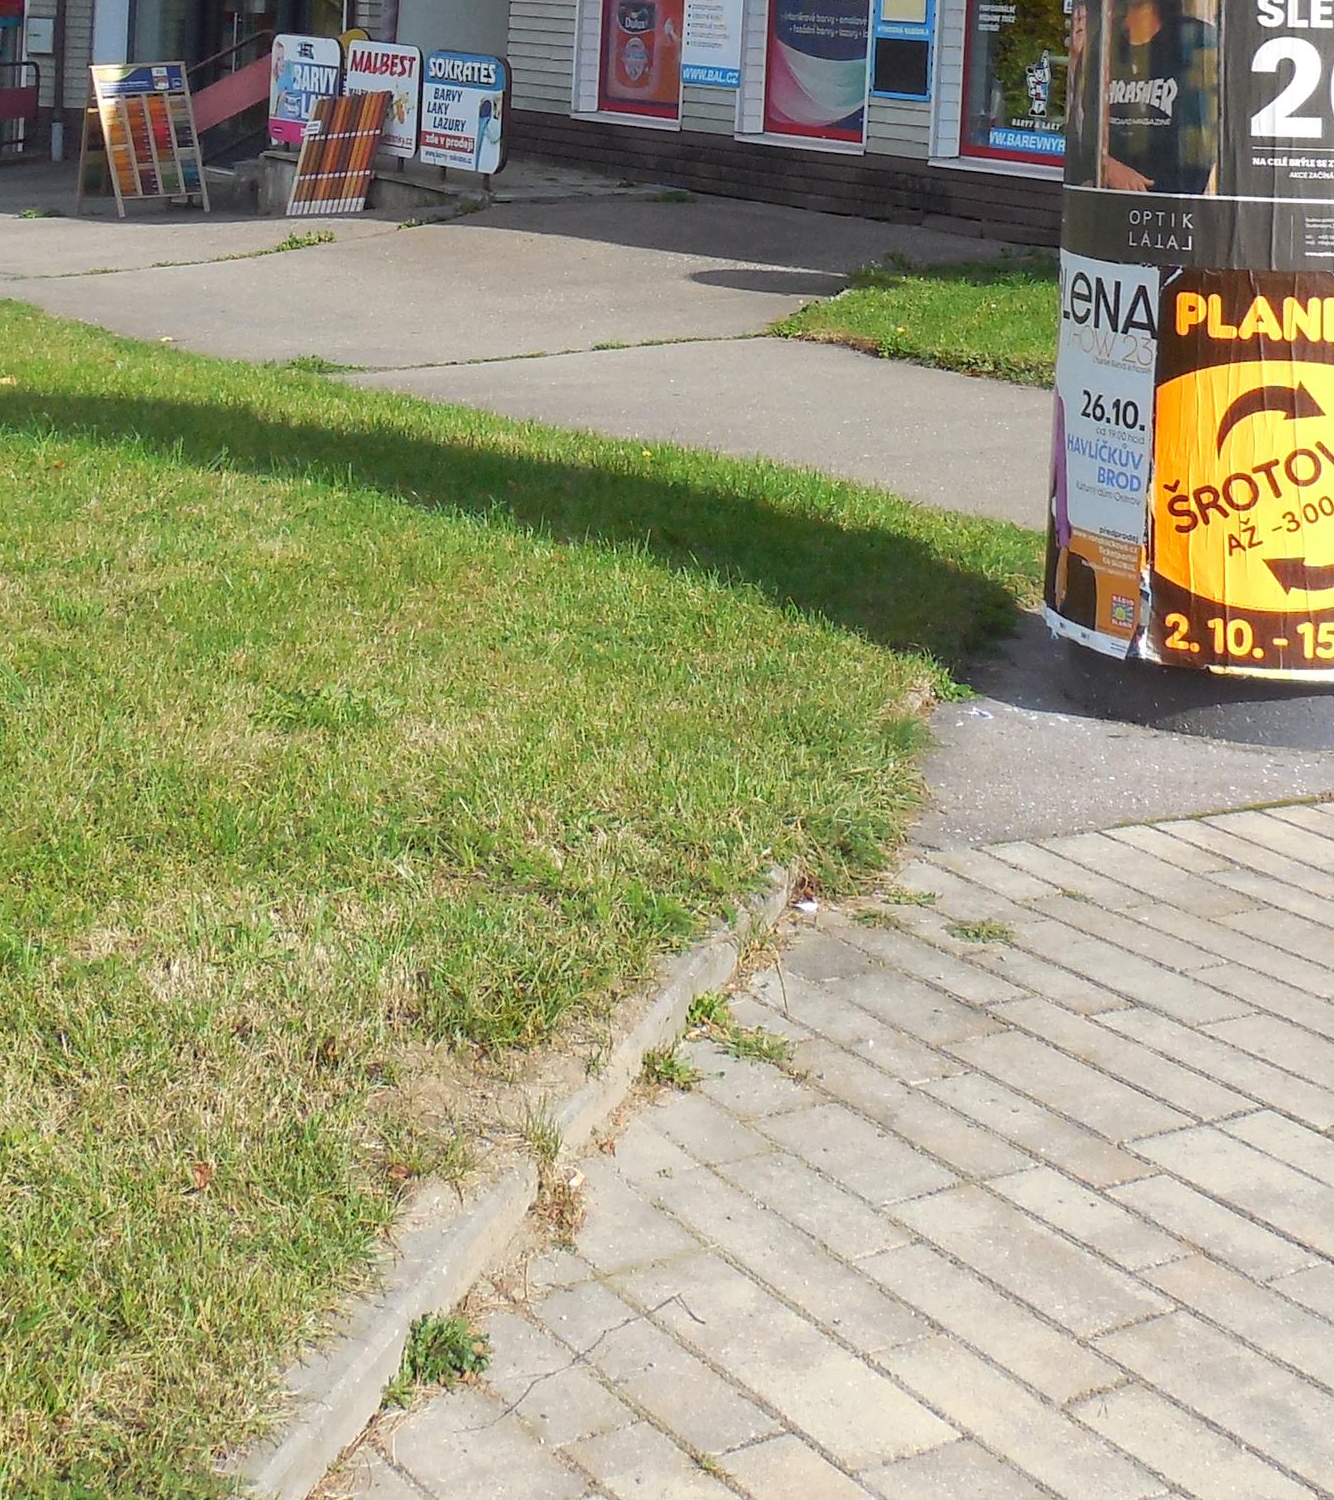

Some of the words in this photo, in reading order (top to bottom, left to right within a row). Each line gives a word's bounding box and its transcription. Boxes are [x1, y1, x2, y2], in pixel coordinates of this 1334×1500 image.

[350, 50, 416, 78] MALBEST
[429, 56, 496, 85] SOKRATES
[683, 68, 739, 85] WWW.BAL.CZ
[293, 64, 337, 95] BARVY
[433, 87, 463, 103] BARVY
[427, 102, 449, 116] LAKY
[433, 116, 467, 133] LAZURY
[445, 137, 474, 154] prodeji
[1252, 157, 1267, 166] NA
[1267, 156, 1288, 167] CELÉ
[1129, 209, 1194, 229] OPTIK
[1121, 334, 1154, 367] 23
[1080, 388, 1146, 432] 26.10.
[1067, 433, 1144, 470] HAVLÍČKŮV
[1097, 466, 1141, 492] BROD
[1227, 516, 1264, 557] AŽ
[1164, 612, 1200, 652] 2.
[1207, 617, 1264, 660] 10.
